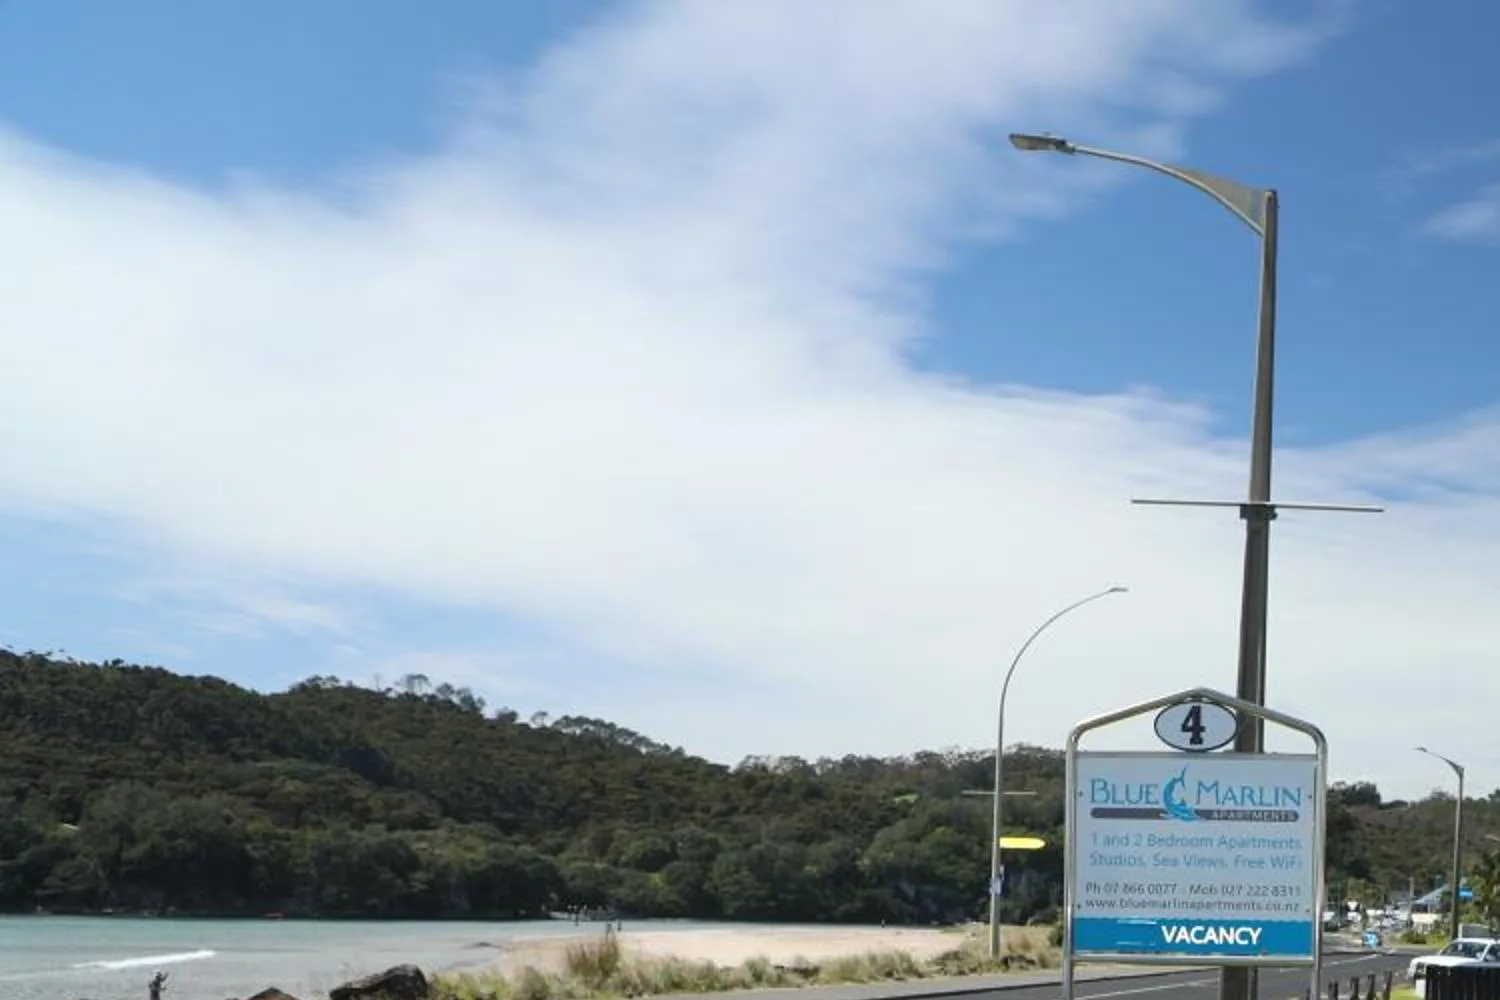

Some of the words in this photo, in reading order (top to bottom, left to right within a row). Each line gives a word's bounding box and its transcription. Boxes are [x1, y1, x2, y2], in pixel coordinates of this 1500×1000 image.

[1181, 705, 1206, 745] 4
[1103, 832, 1130, 847] and
[1133, 833, 1143, 847] 2
[1147, 833, 1214, 848] Bedroom
[1153, 853, 1179, 867] Sea
[1234, 854, 1266, 869] Free
[1085, 882, 1101, 894] Ph
[1104, 882, 1119, 894] 07
[1147, 883, 1177, 895] 0077
[1189, 883, 1218, 895] Mob
[1161, 925, 1262, 945] VACANCY
